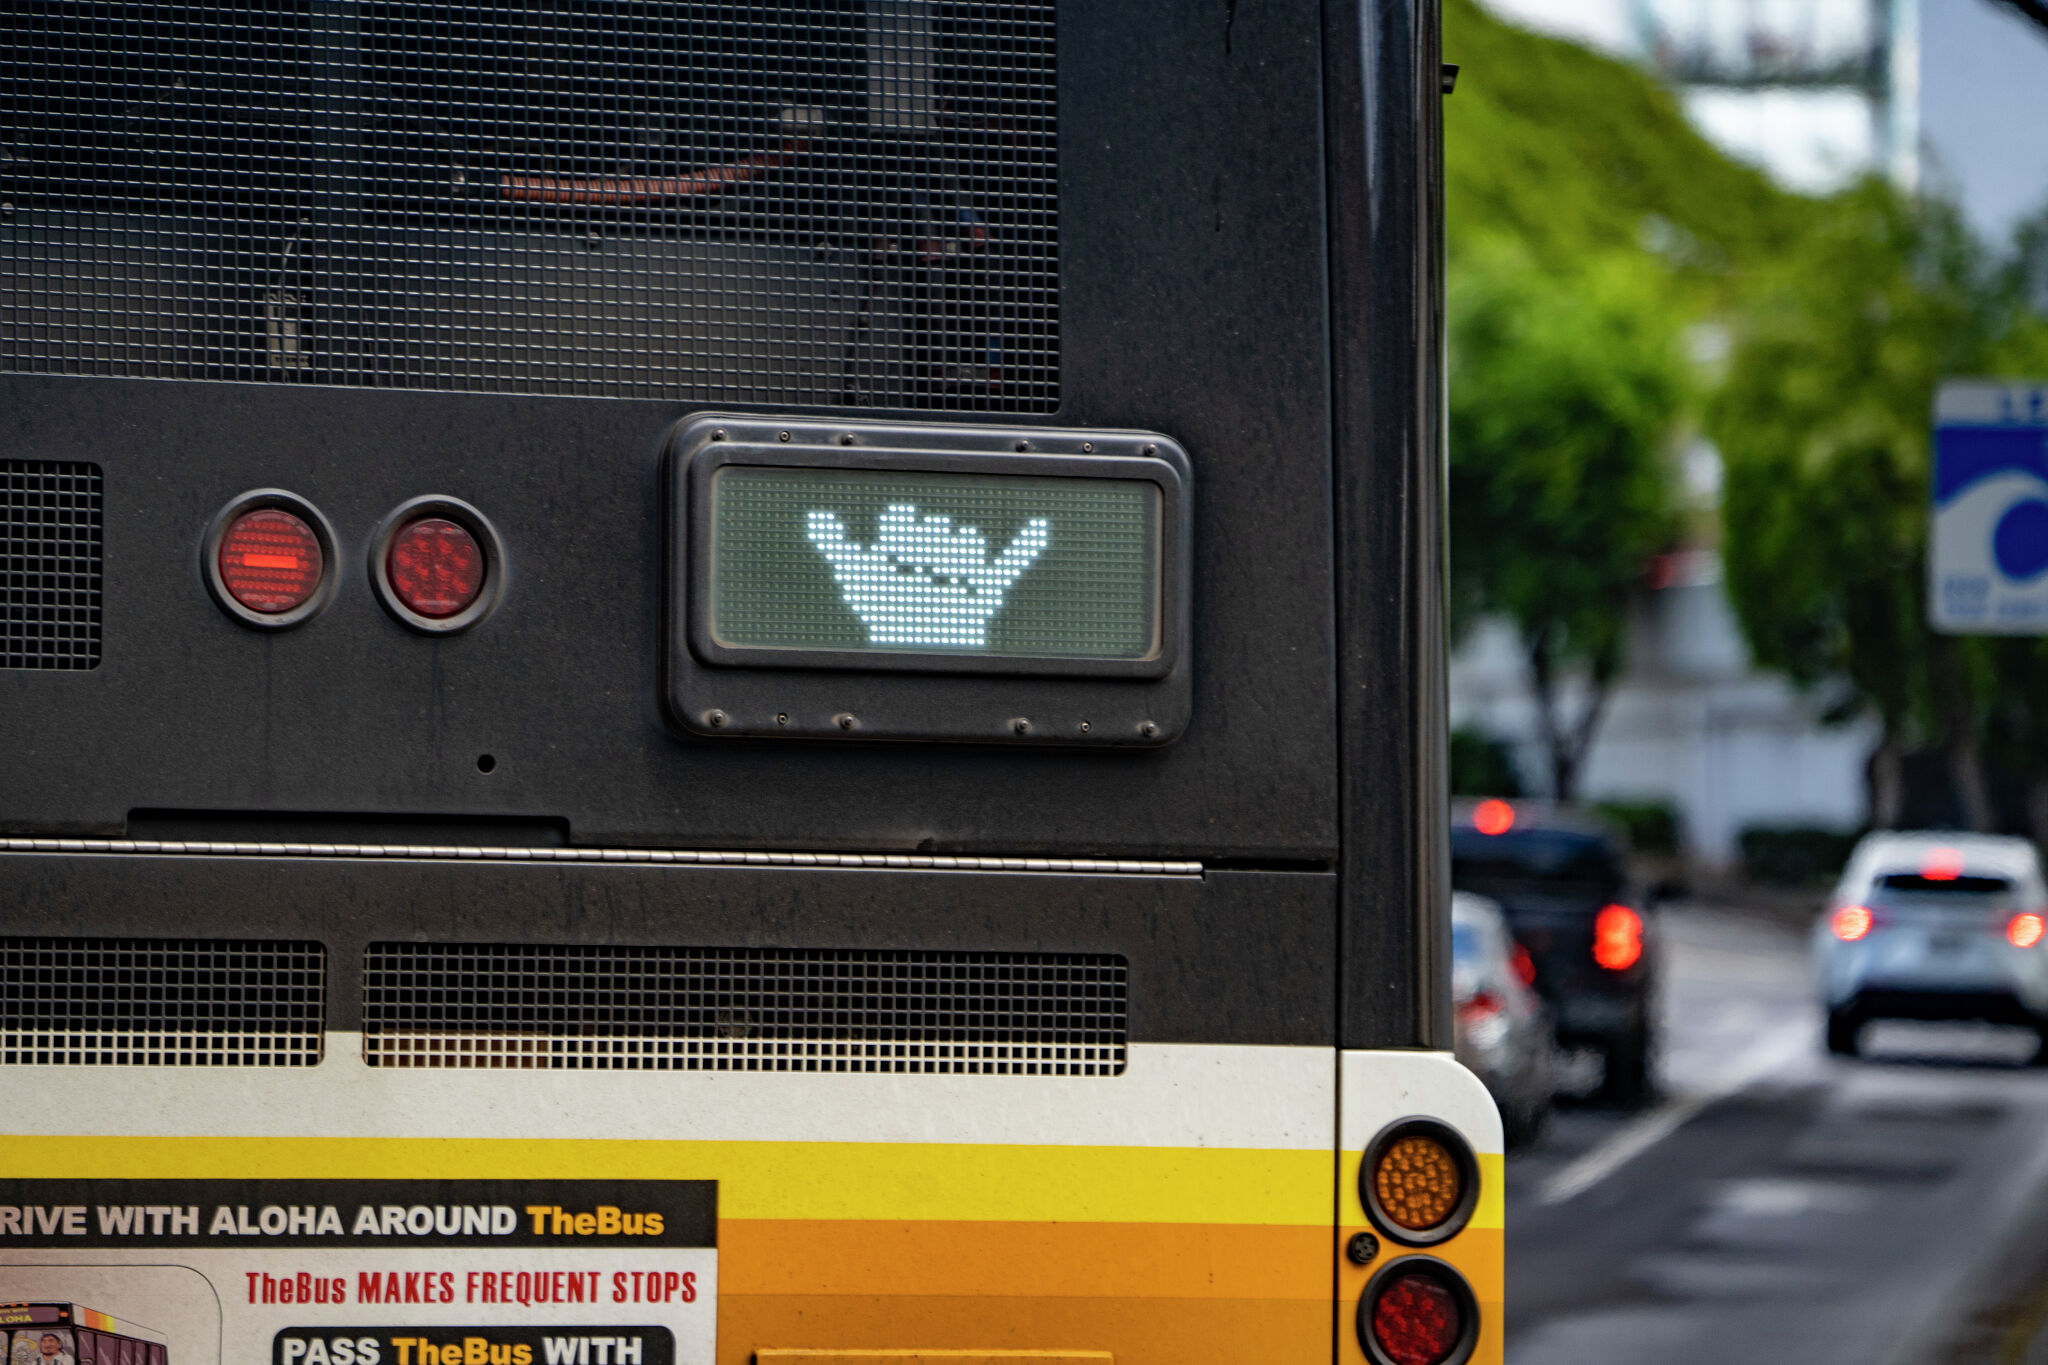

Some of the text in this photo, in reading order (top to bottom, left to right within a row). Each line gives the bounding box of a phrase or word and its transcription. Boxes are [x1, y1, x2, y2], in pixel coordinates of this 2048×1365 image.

[0, 1206, 665, 1235] RIVE WITH ALOHA AROUND TheBus
[246, 1272, 697, 1307] TheBus MAKES FREQUENT STOPS
[283, 1337, 642, 1365] PASS TheBus WITH
